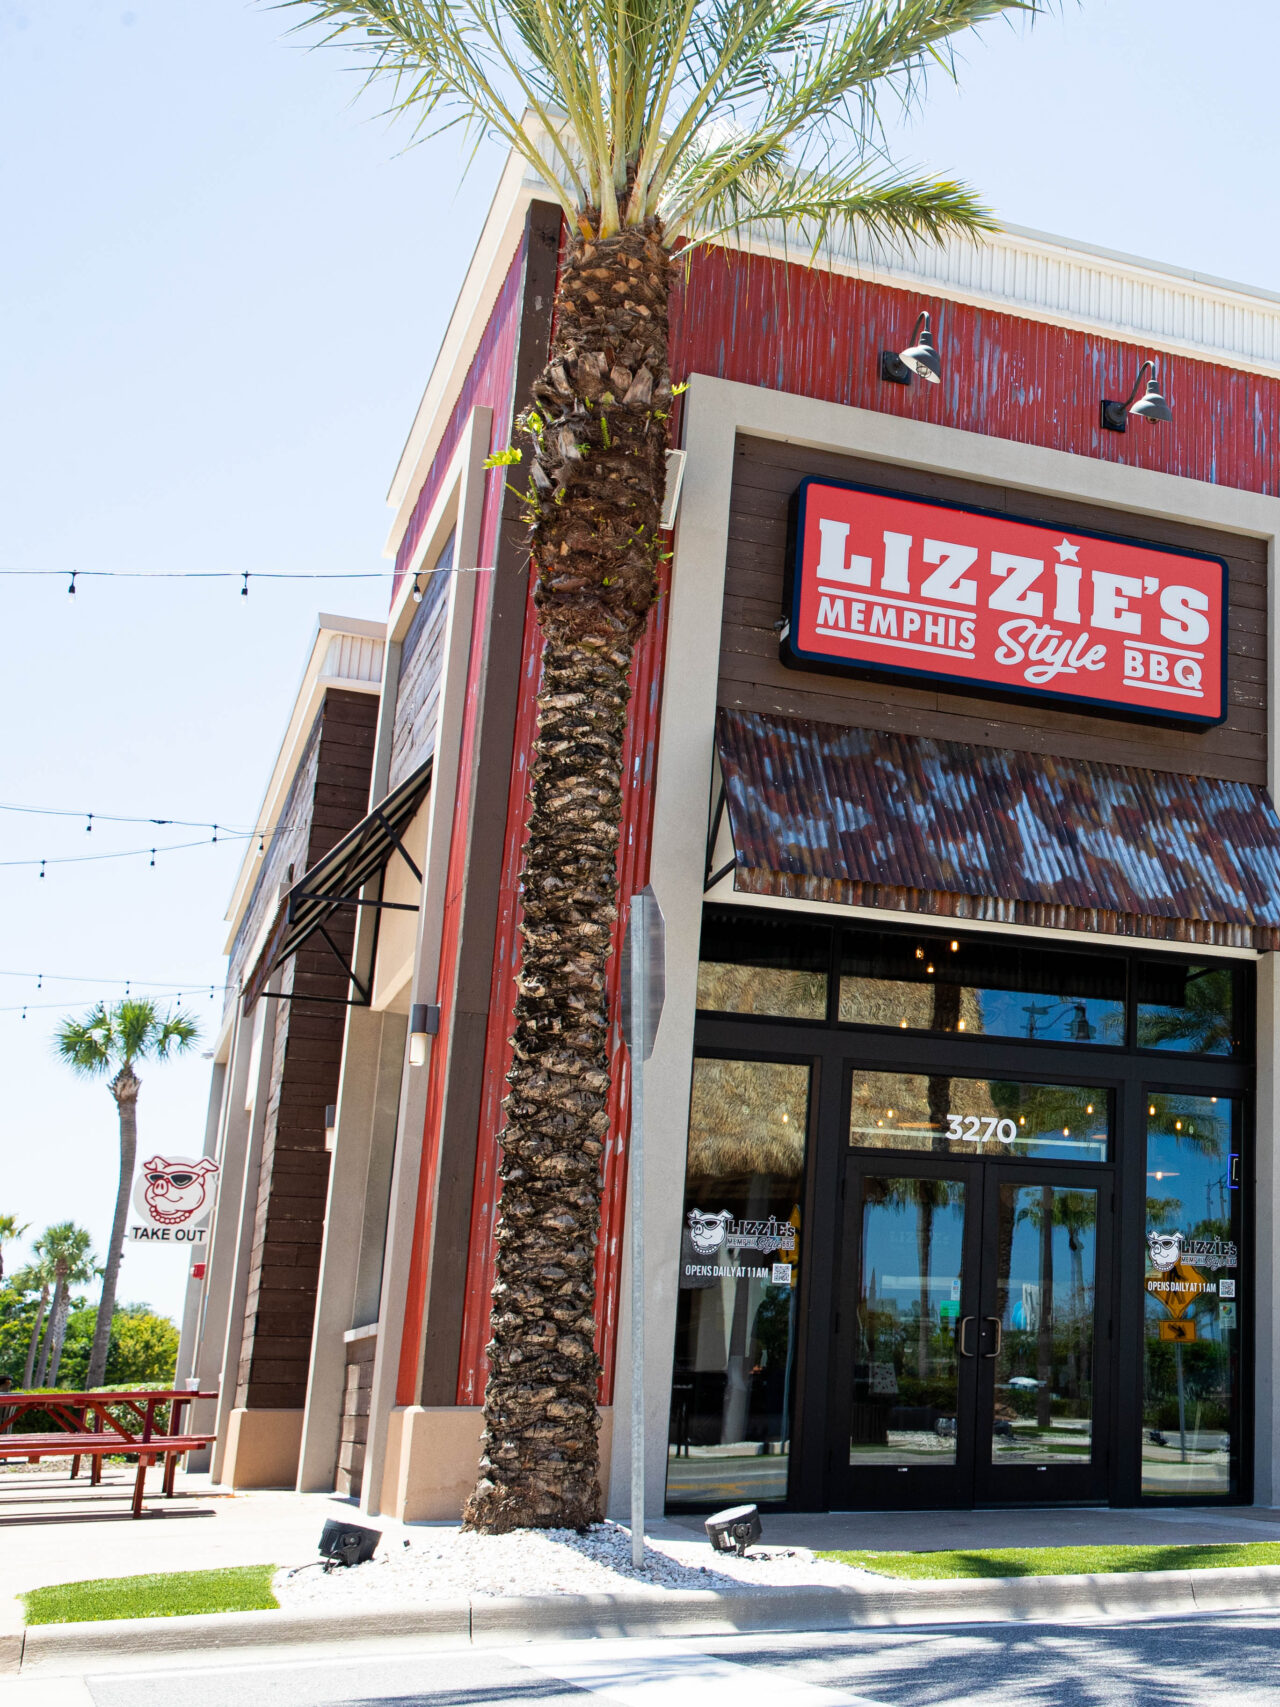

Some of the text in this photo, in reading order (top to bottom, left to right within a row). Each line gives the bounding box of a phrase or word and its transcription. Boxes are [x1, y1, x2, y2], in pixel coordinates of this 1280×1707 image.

[816, 518, 1210, 645] LIZZIE'S
[816, 596, 1203, 690] MEMPHIS Style BBQ
[945, 1114, 1017, 1143] 3270
[133, 1227, 206, 1241] TAKE OUT
[685, 1265, 769, 1278] OPENS DAILY AT 11AM
[1147, 1281, 1217, 1293] OPENS DAILY AT 11AM
